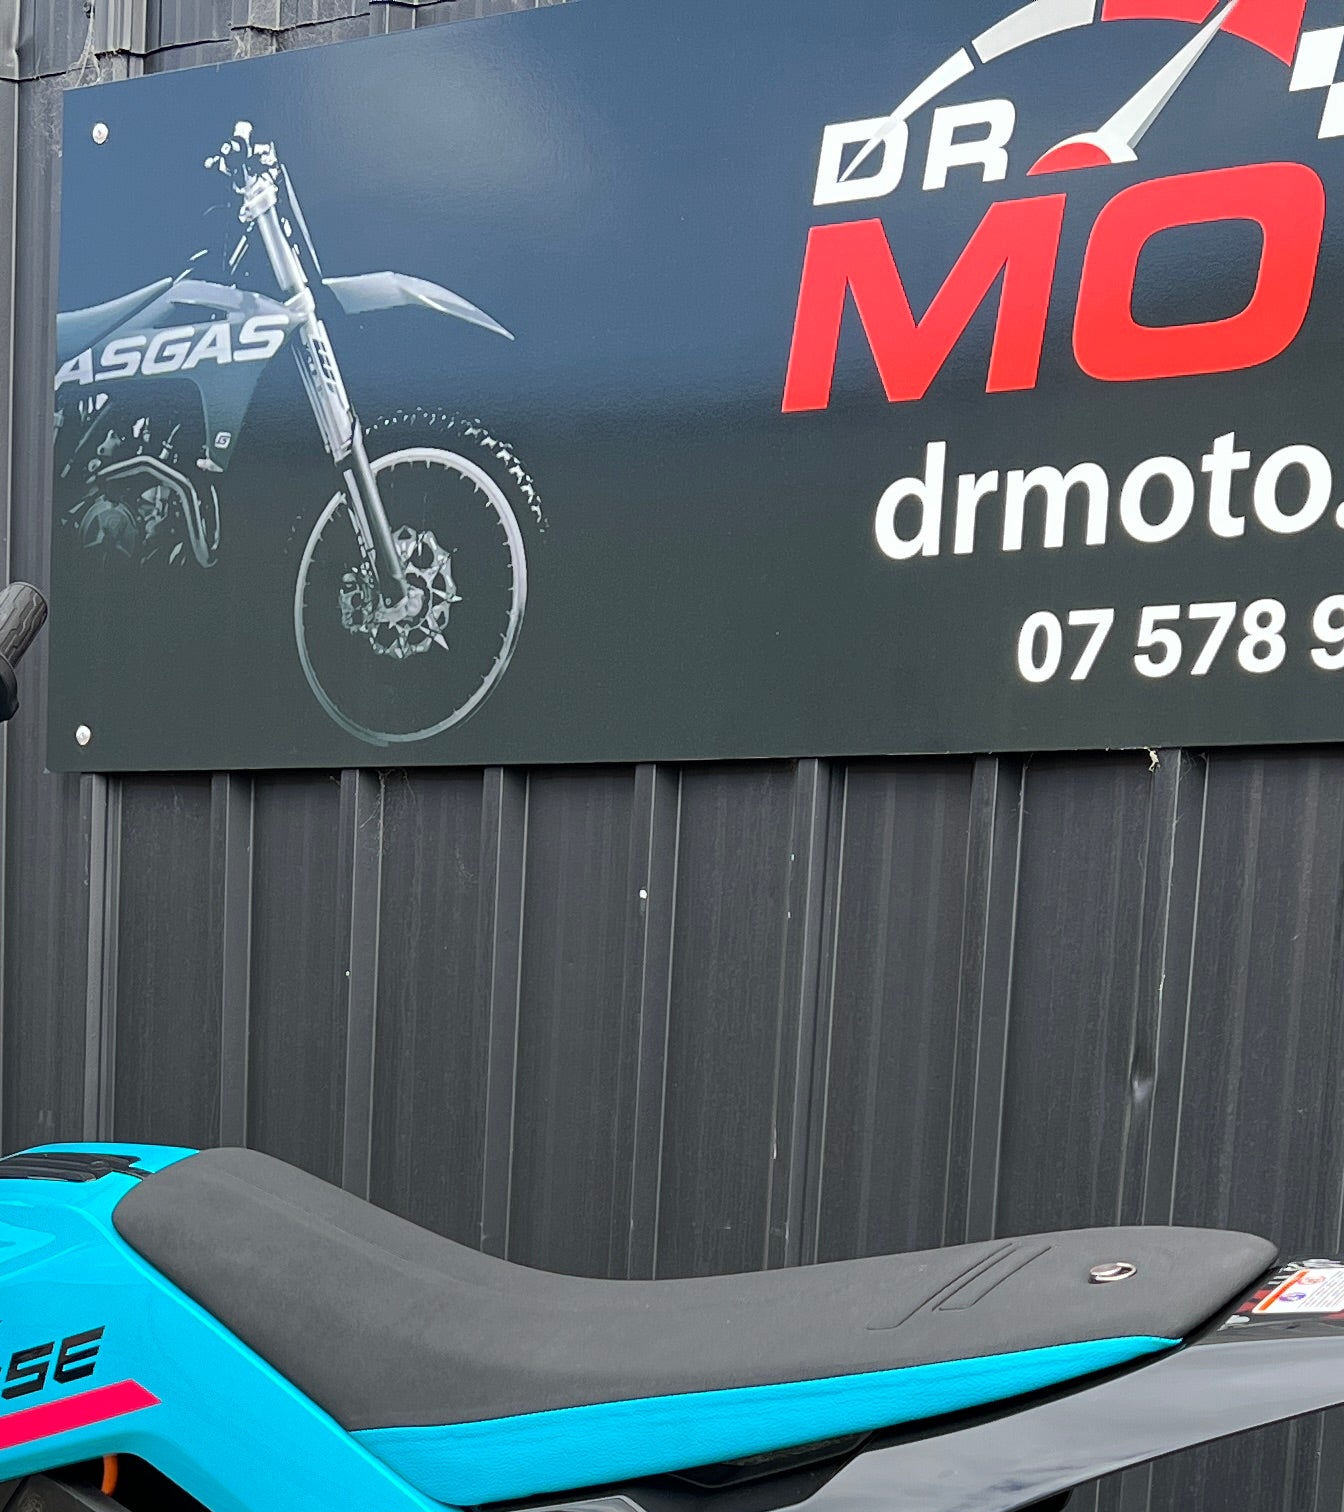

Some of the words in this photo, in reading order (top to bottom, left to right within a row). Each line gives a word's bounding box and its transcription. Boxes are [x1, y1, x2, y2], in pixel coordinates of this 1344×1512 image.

[813, 99, 1016, 206] DR
[1016, 607, 1115, 684] 07
[1133, 597, 1287, 679] 578
